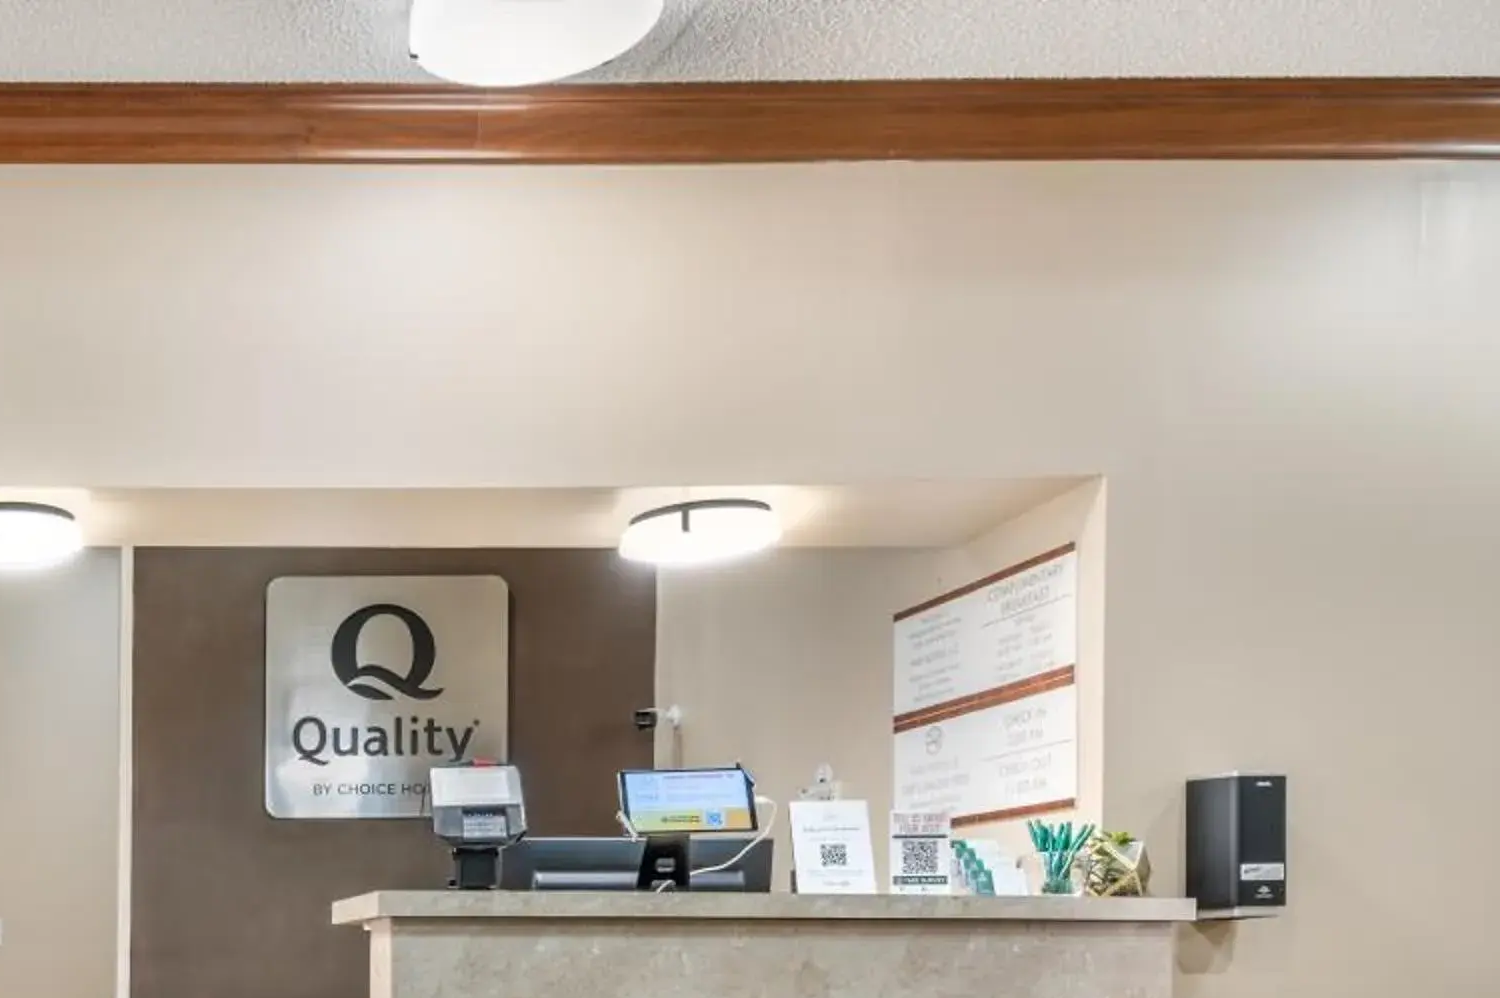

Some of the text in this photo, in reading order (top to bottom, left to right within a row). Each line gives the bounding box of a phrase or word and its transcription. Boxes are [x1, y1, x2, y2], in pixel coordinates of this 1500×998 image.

[292, 715, 475, 766] Quality
[313, 783, 332, 796] BY
[337, 783, 397, 796] CHOICE
